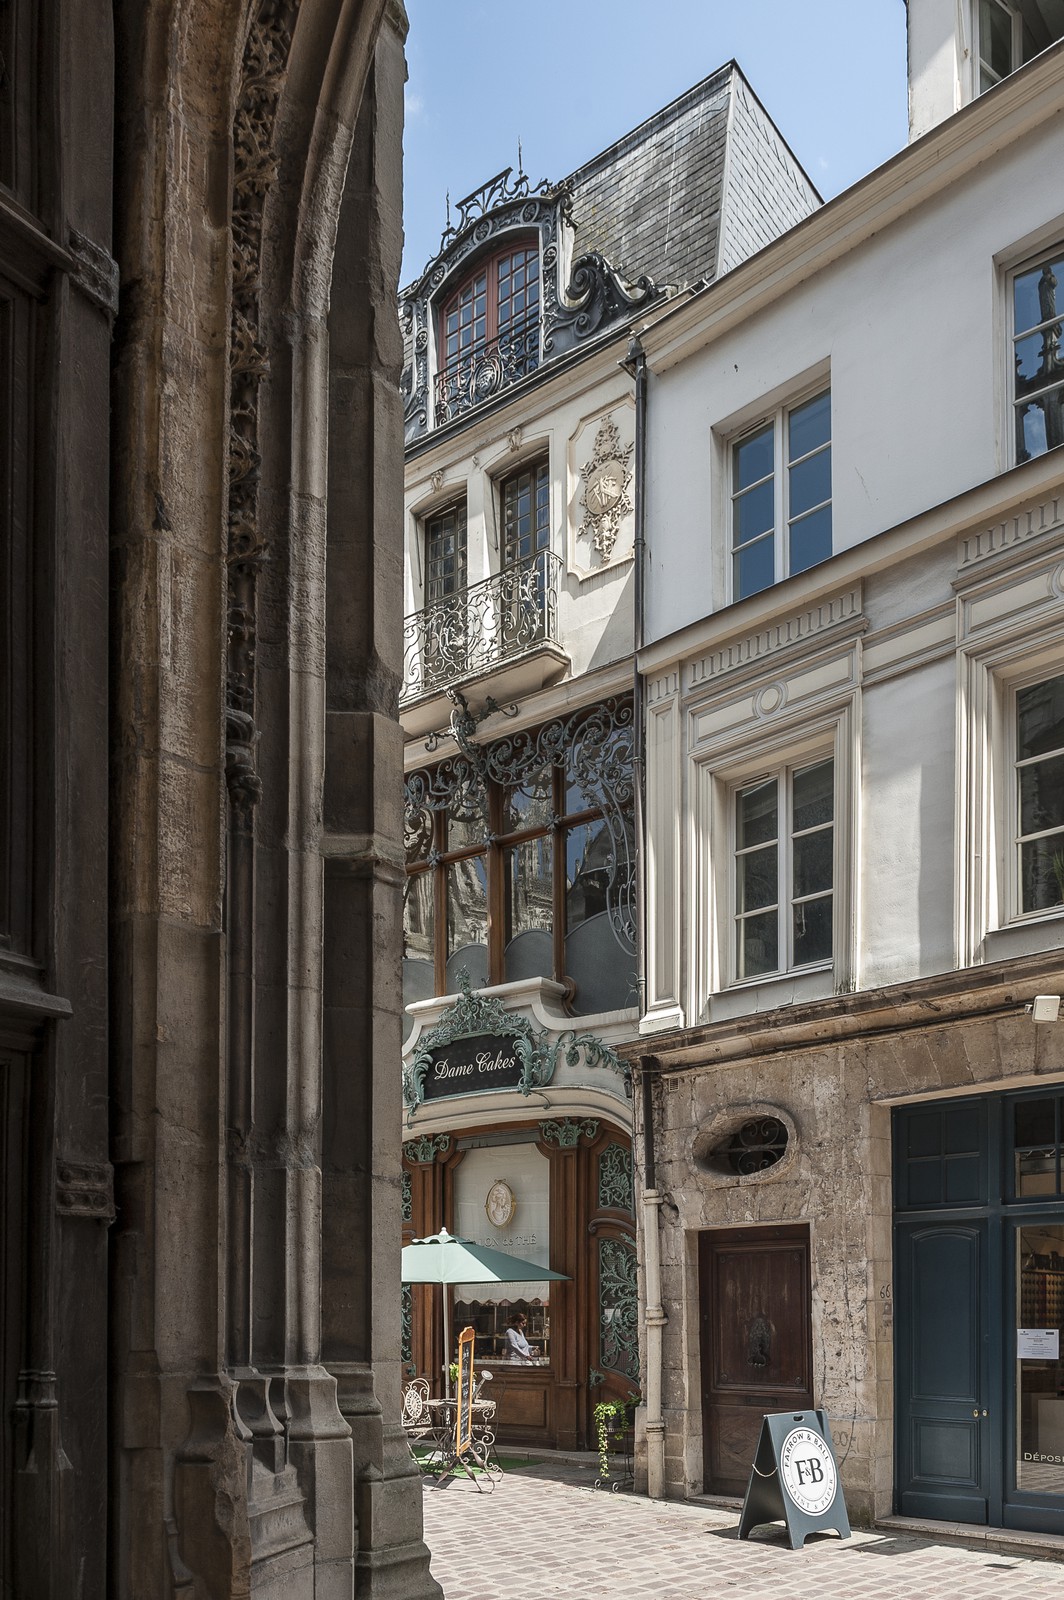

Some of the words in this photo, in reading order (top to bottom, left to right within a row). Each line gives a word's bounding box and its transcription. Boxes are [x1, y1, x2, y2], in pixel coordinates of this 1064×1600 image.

[434, 1058, 474, 1080] Dame
[475, 1050, 515, 1073] Cakes
[880, 1283, 891, 1299] 66
[784, 1432, 804, 1468] FARROW
[806, 1433, 812, 1441] &
[814, 1438, 829, 1462] BALL
